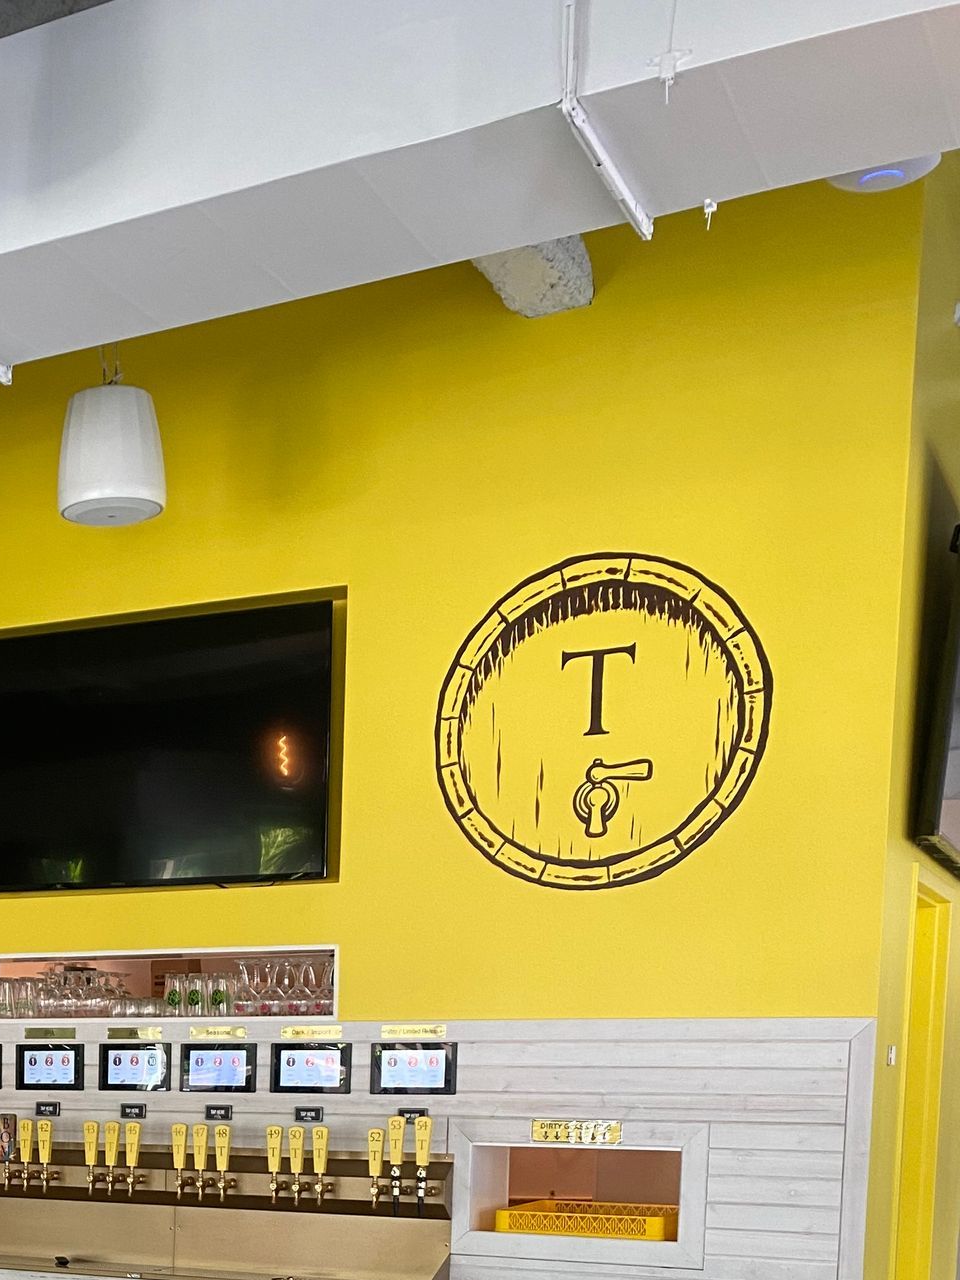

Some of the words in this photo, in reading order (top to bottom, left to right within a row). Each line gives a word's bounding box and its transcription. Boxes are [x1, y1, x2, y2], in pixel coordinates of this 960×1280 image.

[561, 642, 637, 737] T
[39, 1123, 48, 1132] 42
[391, 1120, 401, 1130] 53
[417, 1121, 428, 1130] 54
[540, 1122, 562, 1130] DIRTY
[194, 1128, 205, 1137] 47
[216, 1129, 227, 1138] 48
[268, 1129, 280, 1139] 49
[290, 1130, 301, 1140] 50
[316, 1130, 323, 1140] 51
[370, 1132, 381, 1142] 52
[21, 1139, 28, 1148] T
[40, 1140, 47, 1149] T
[86, 1141, 94, 1151] T
[107, 1142, 115, 1151] T
[128, 1143, 135, 1152] T
[391, 1139, 400, 1149] T
[418, 1140, 427, 1150] T
[174, 1144, 183, 1154] T
[195, 1145, 203, 1155] T
[217, 1146, 226, 1156] T
[269, 1147, 278, 1157] T
[291, 1148, 300, 1158] T
[315, 1148, 323, 1158] T
[371, 1151, 380, 1160] T
